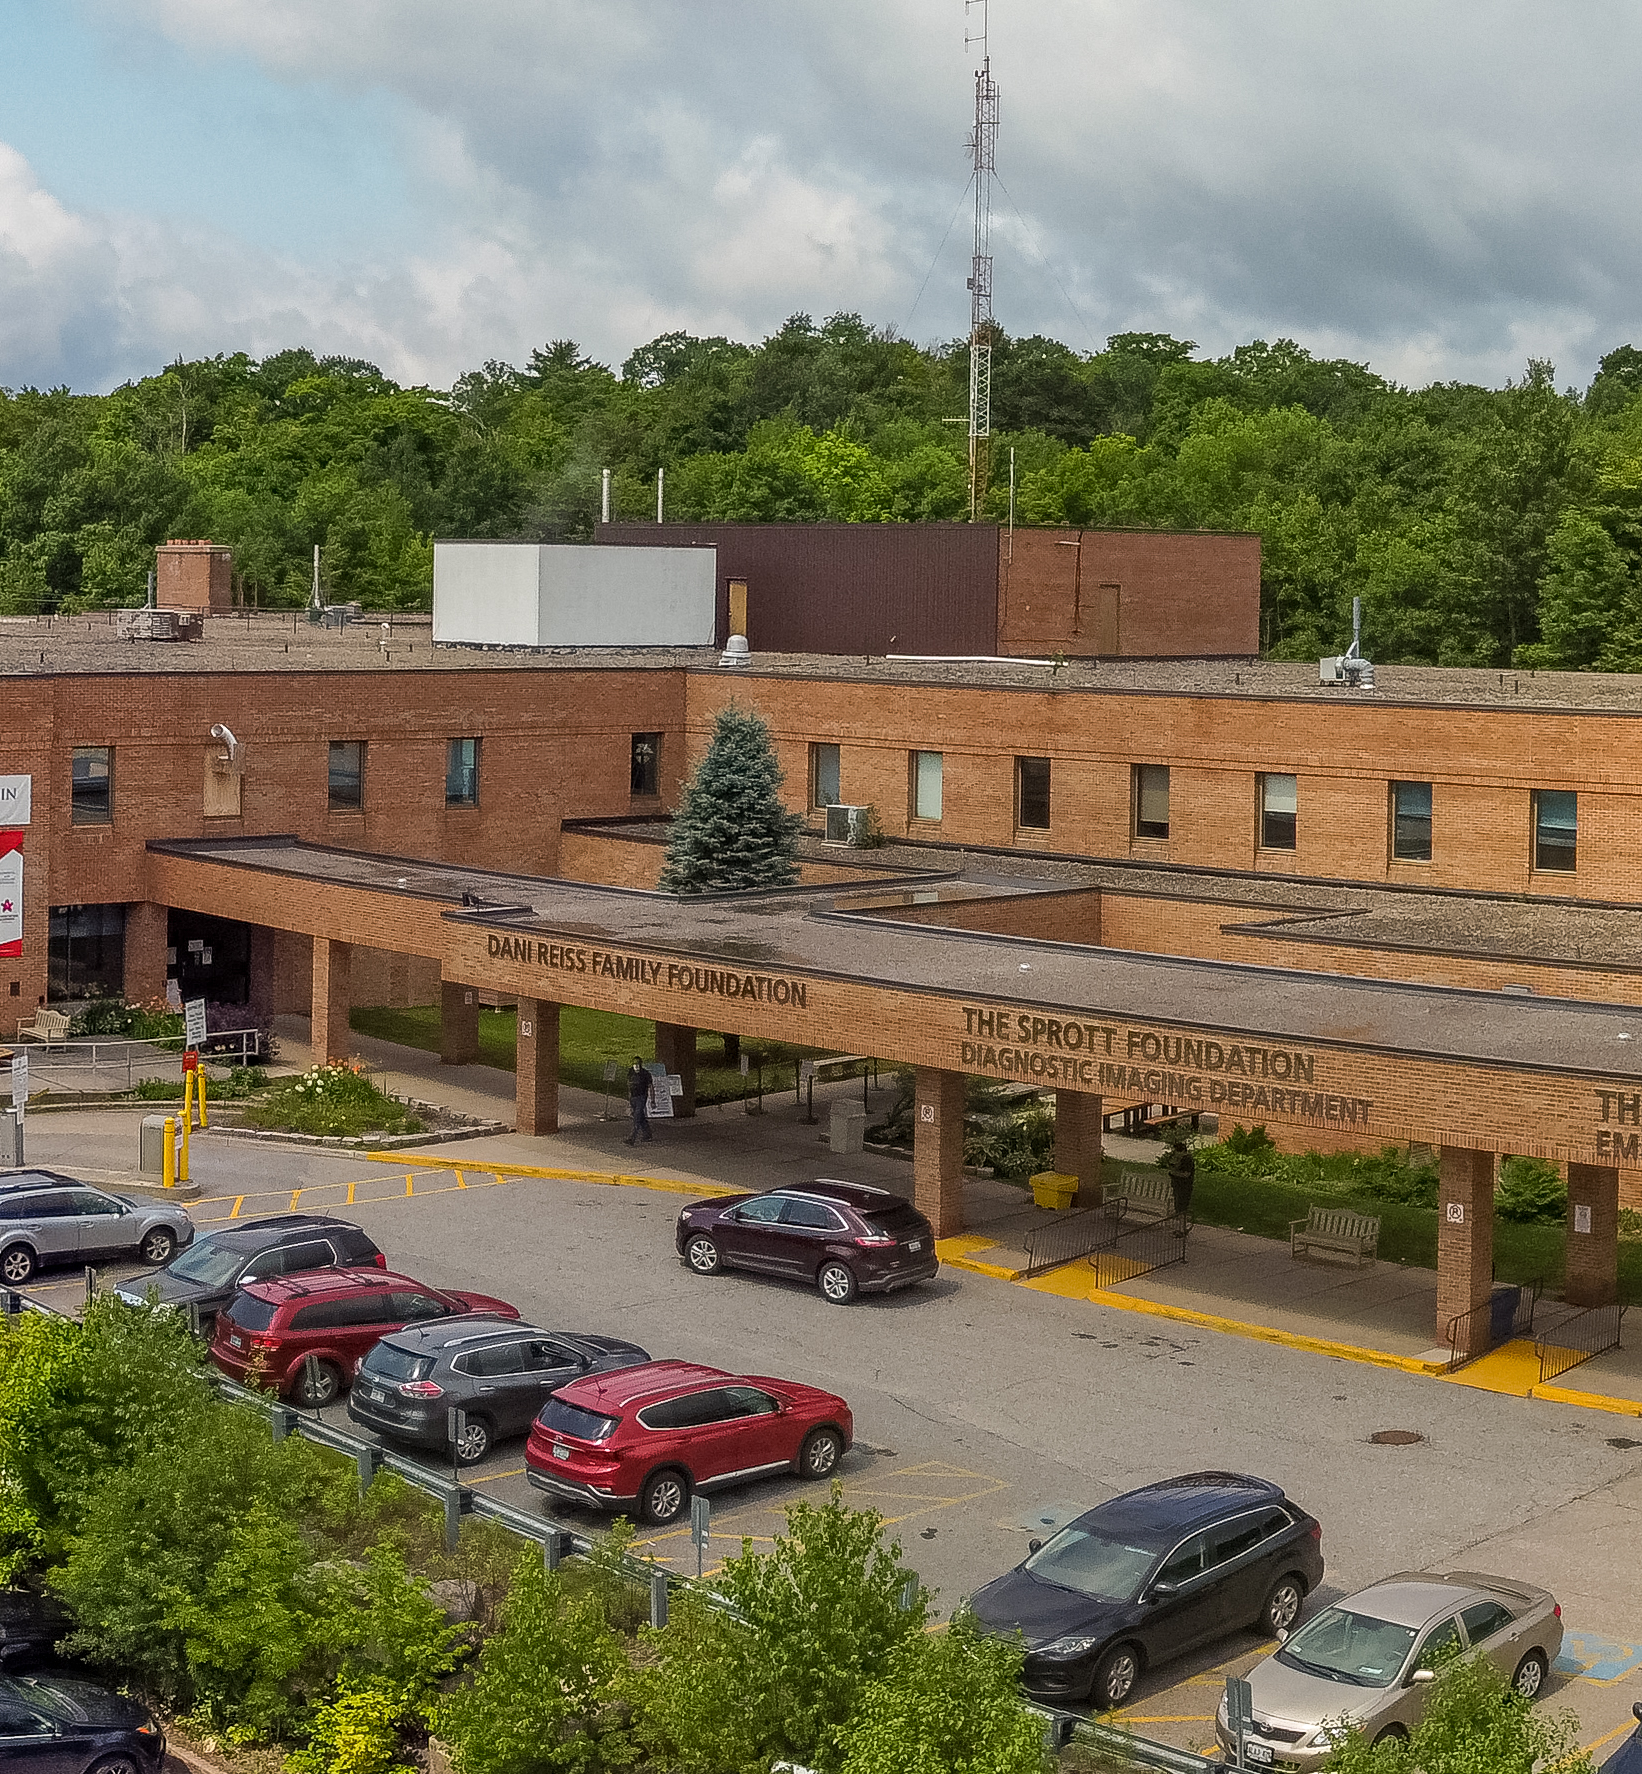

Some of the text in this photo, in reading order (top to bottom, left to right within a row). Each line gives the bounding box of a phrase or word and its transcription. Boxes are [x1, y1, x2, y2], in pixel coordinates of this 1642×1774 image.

[487, 934, 807, 1009] DANI REISS FAMILY FOUNDATION
[962, 1007, 1315, 1083] THE SPROTT FOUNDATION
[962, 1040, 1373, 1124] DIAGNOSTIC IMAGING DEPARTMENT
